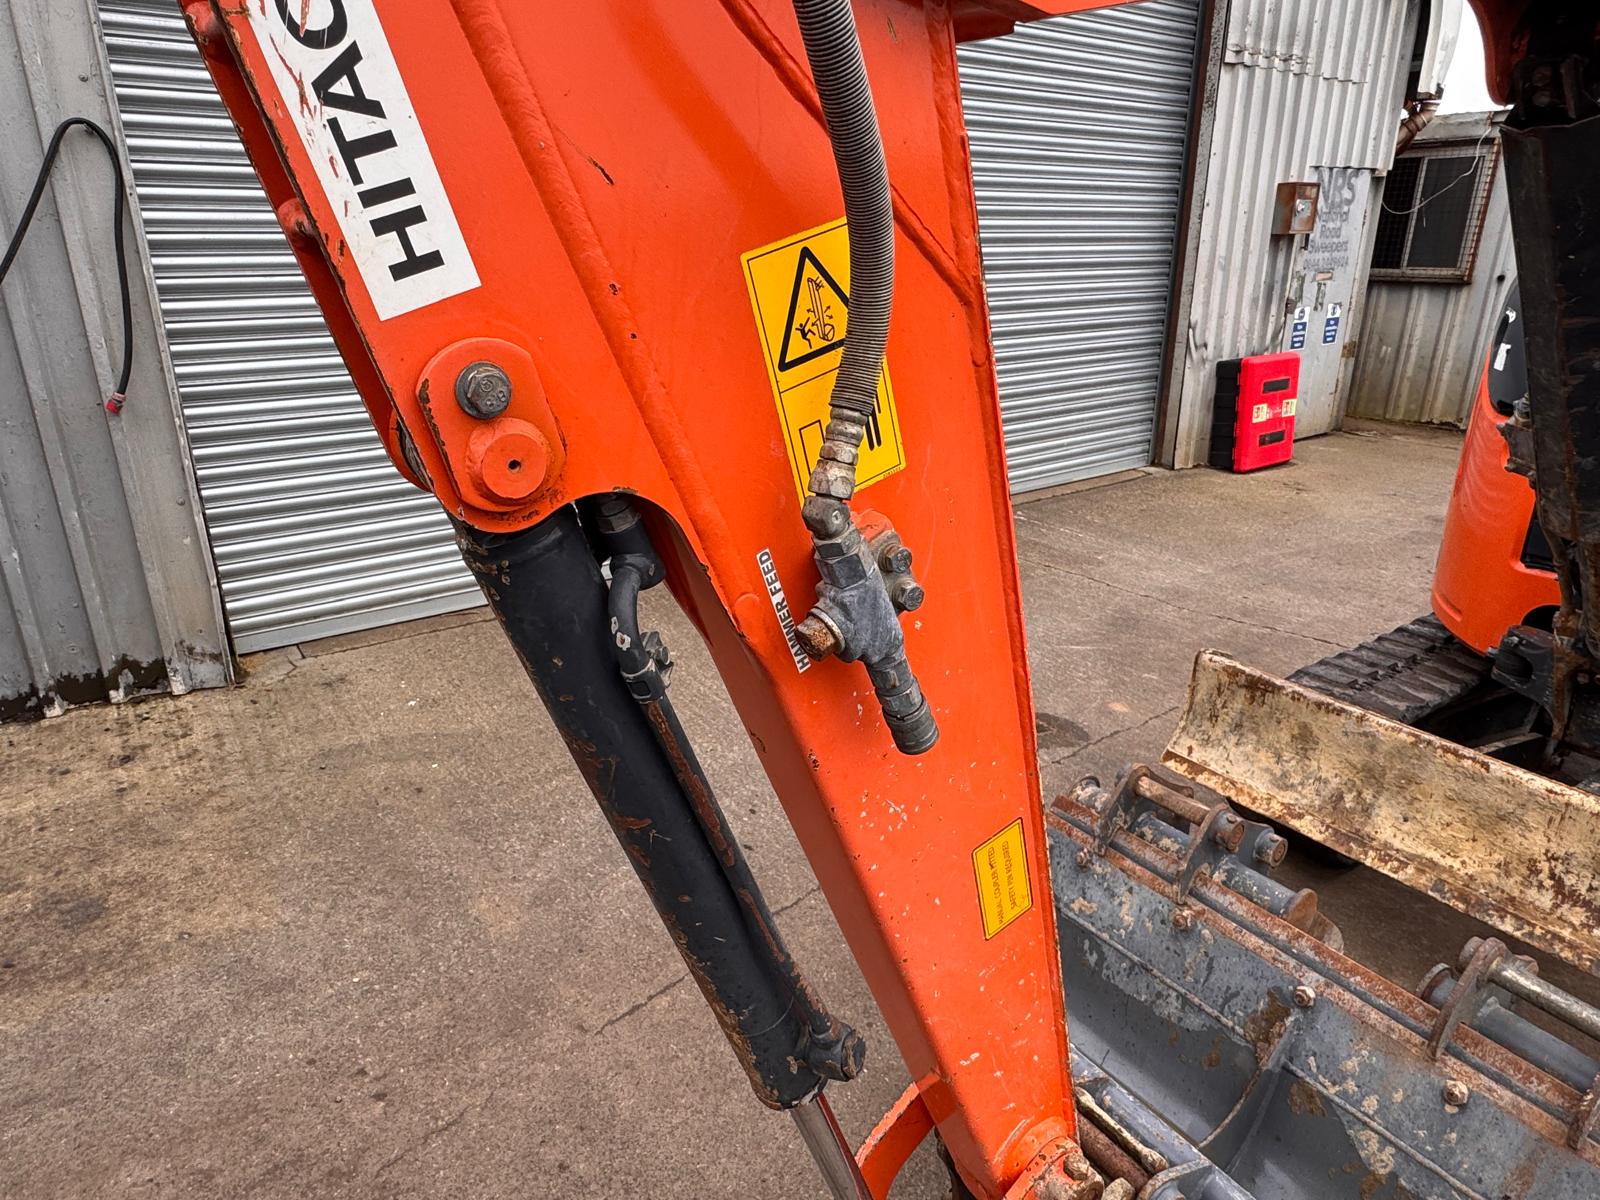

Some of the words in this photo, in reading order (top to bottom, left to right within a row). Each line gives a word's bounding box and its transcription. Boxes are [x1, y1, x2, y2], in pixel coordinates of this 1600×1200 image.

[274, 0, 445, 281] HITAC
[1318, 168, 1360, 209] NRS
[1308, 239, 1349, 256] Sweepers
[1319, 222, 1342, 239] Road
[759, 551, 782, 597] FEED
[775, 597, 810, 671] HAMMER
[987, 846, 997, 870] FITTED
[1002, 840, 1013, 874] REQUIRED
[1008, 886, 1018, 910] SAFETY
